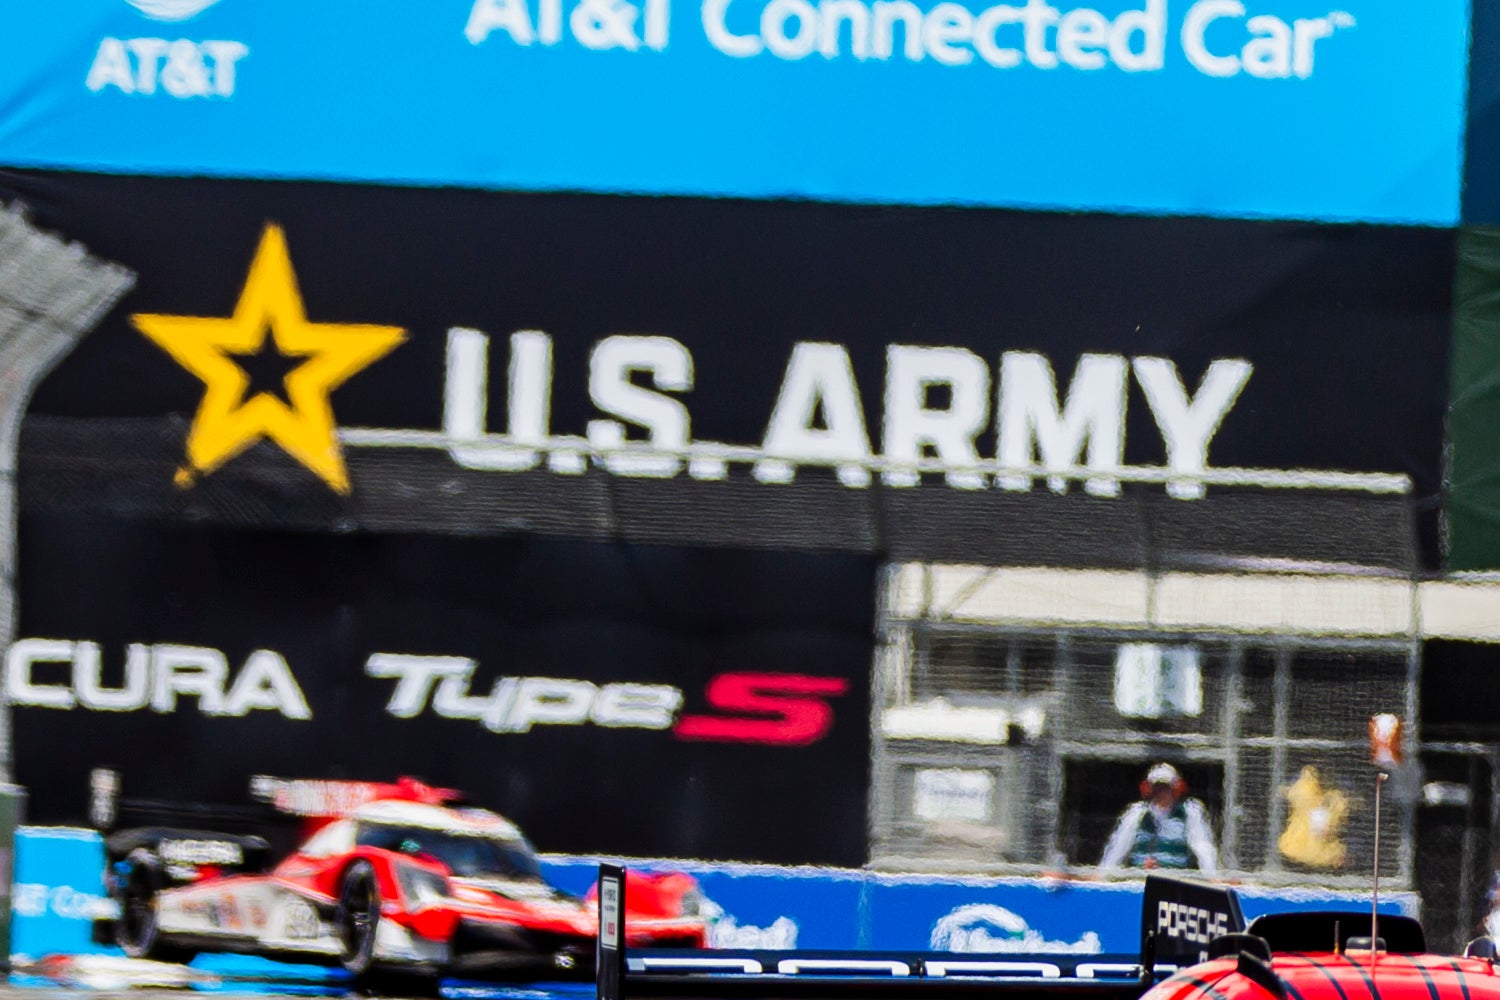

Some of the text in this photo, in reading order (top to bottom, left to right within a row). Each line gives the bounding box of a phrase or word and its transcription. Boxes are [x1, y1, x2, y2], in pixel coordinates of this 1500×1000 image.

[85, 36, 249, 98] AT&T
[700, 0, 1167, 72] Connected
[441, 326, 1254, 500] U.S. ARMY
[672, 671, 850, 746] S
